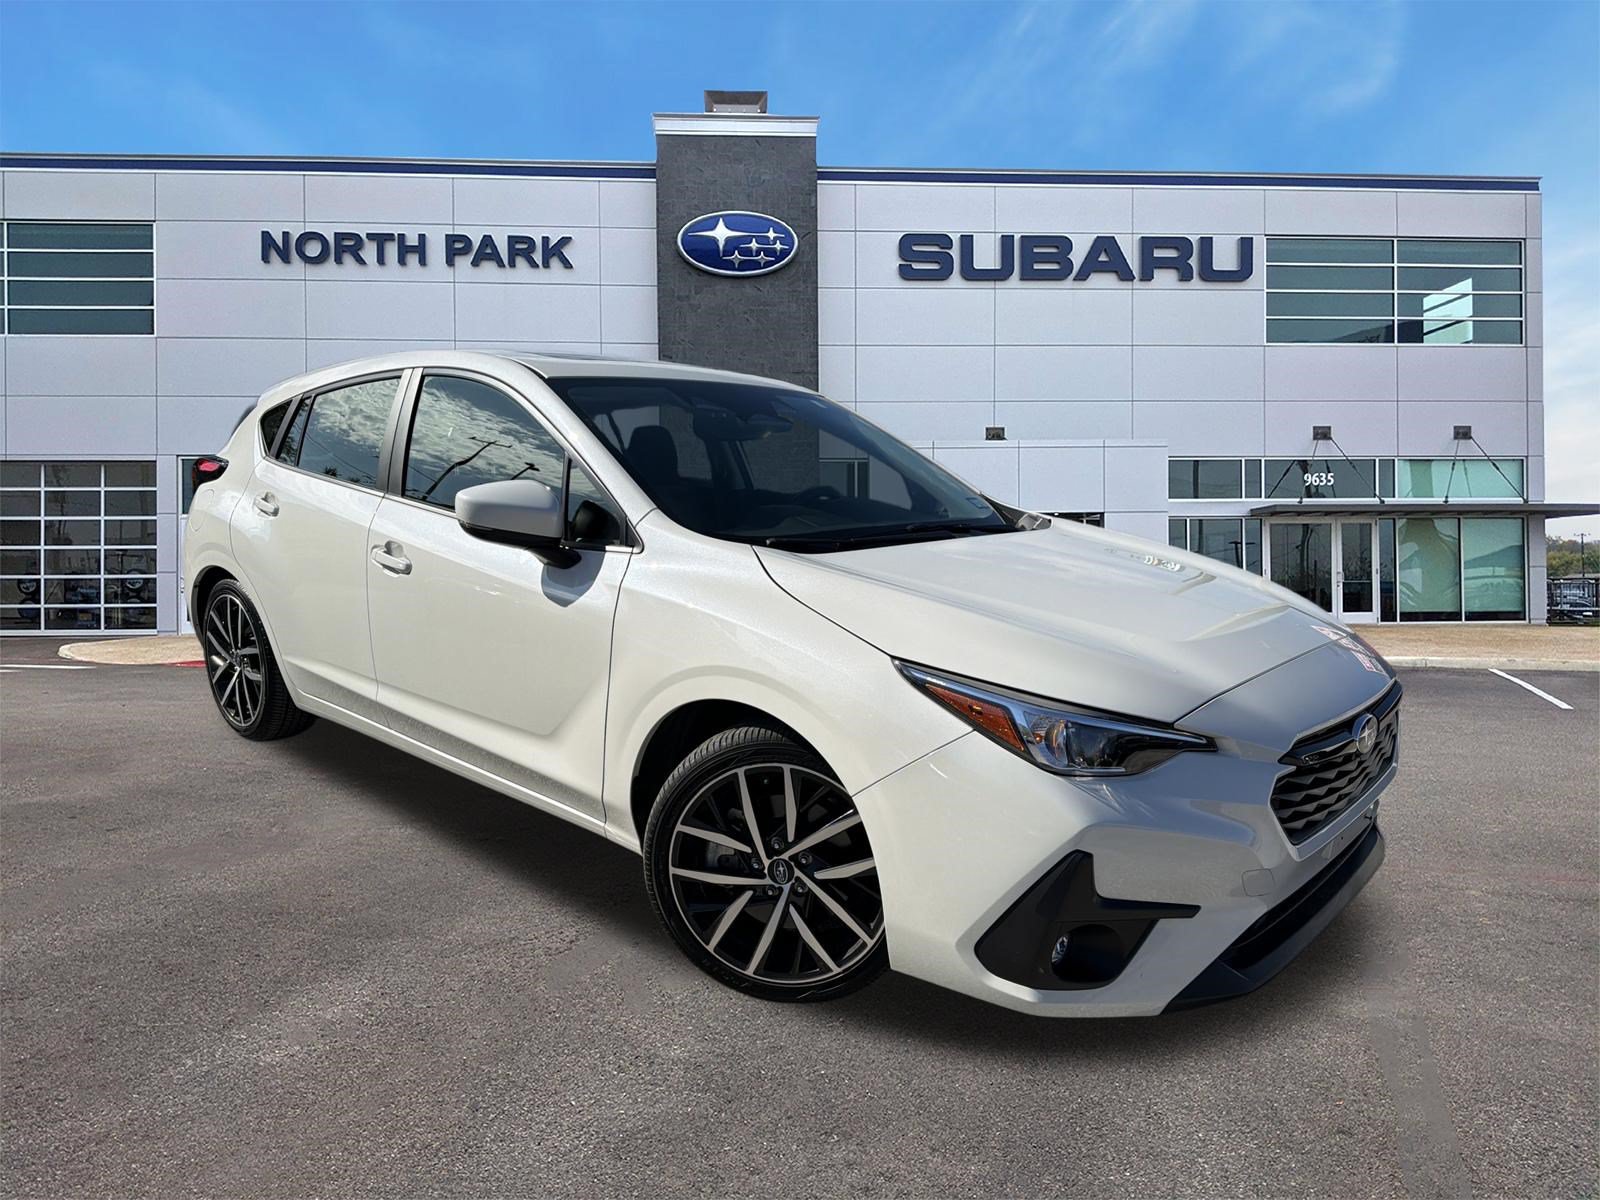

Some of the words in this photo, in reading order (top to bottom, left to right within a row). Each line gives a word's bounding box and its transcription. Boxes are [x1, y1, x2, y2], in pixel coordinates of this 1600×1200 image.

[260, 230, 427, 267] NORTH
[445, 234, 574, 270] PARK
[897, 233, 1254, 283] SUBARU
[1303, 472, 1335, 486] 9635
